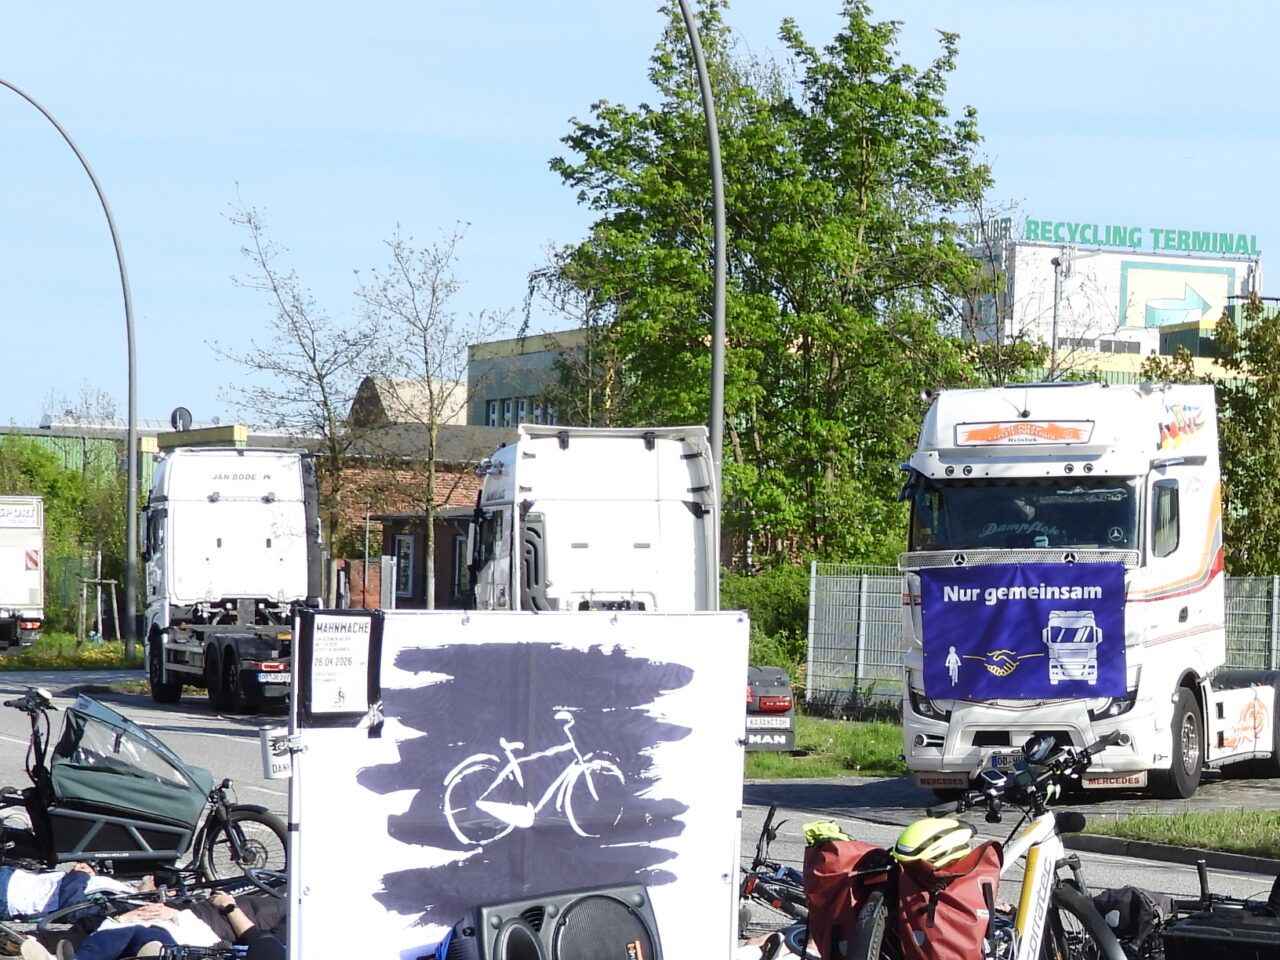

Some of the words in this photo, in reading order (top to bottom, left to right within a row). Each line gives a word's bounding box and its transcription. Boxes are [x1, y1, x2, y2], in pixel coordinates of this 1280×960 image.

[1025, 219, 1142, 248] RECYCLING
[1150, 228, 1262, 255] TERMINAL
[943, 585, 980, 602] Nur
[985, 583, 1102, 605] gemeinsam
[316, 622, 370, 634] MAHNWACHE
[749, 734, 786, 744] MAN
[920, 778, 963, 786] MERCEDES
[1088, 776, 1140, 785] MERCEDES
